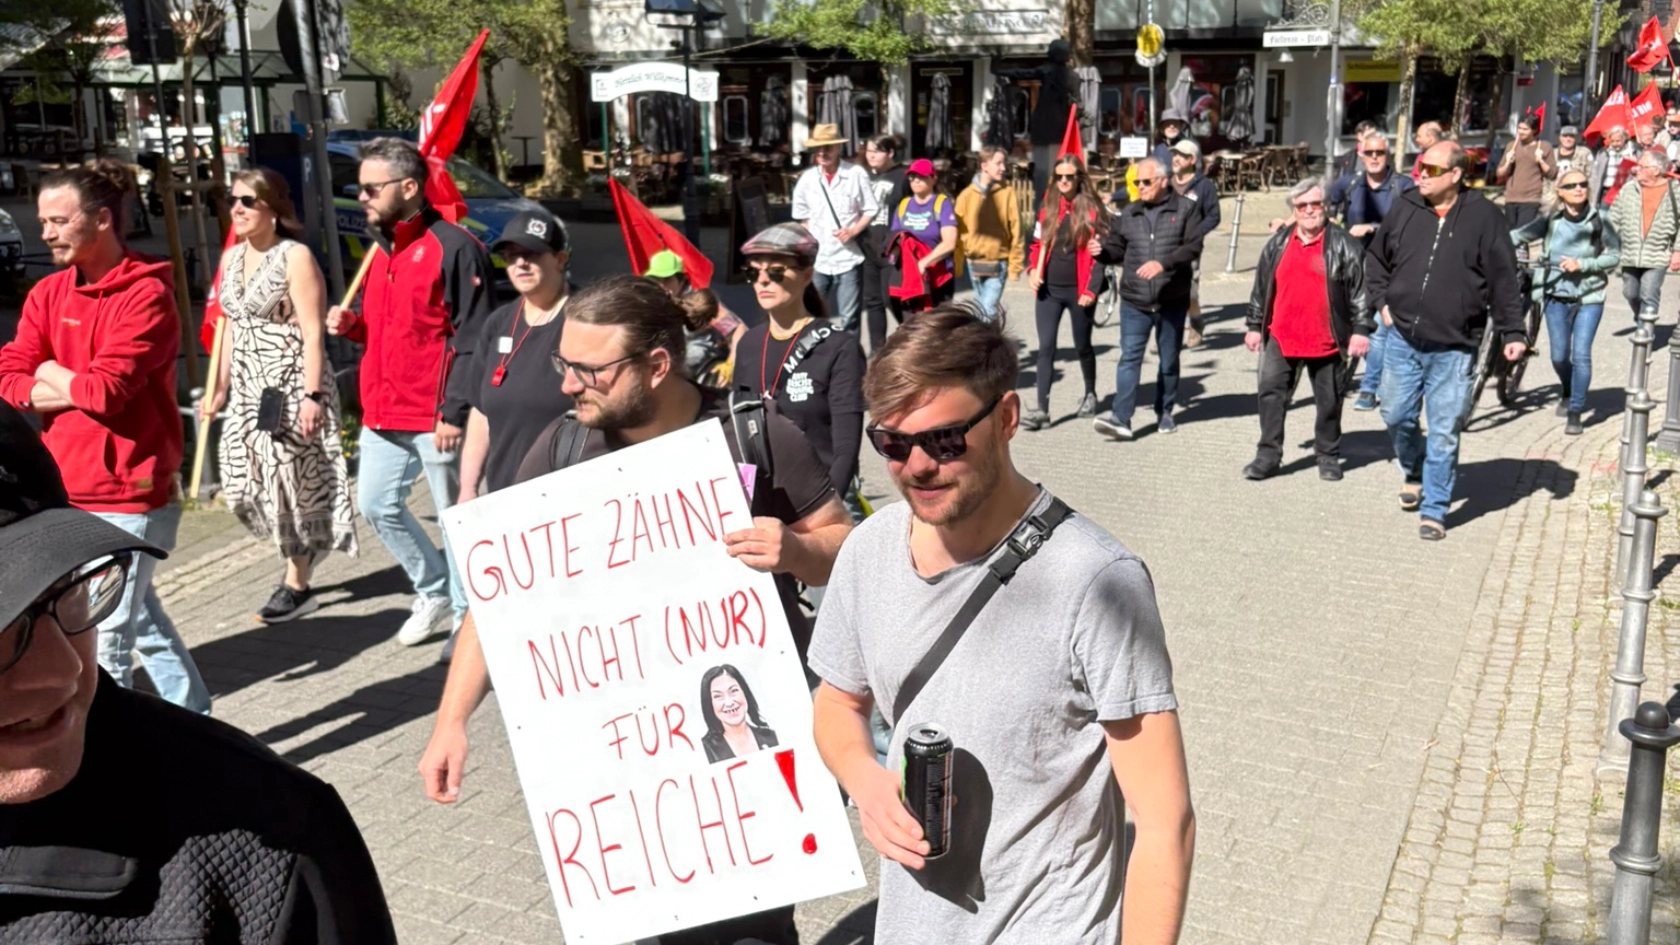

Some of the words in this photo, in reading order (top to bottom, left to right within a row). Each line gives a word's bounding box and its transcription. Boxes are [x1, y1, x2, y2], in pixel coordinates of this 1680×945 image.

[466, 513, 583, 601] GUTE
[528, 615, 645, 700] NICHT
[664, 587, 766, 664] (NUR)
[602, 703, 695, 760] FÜR
